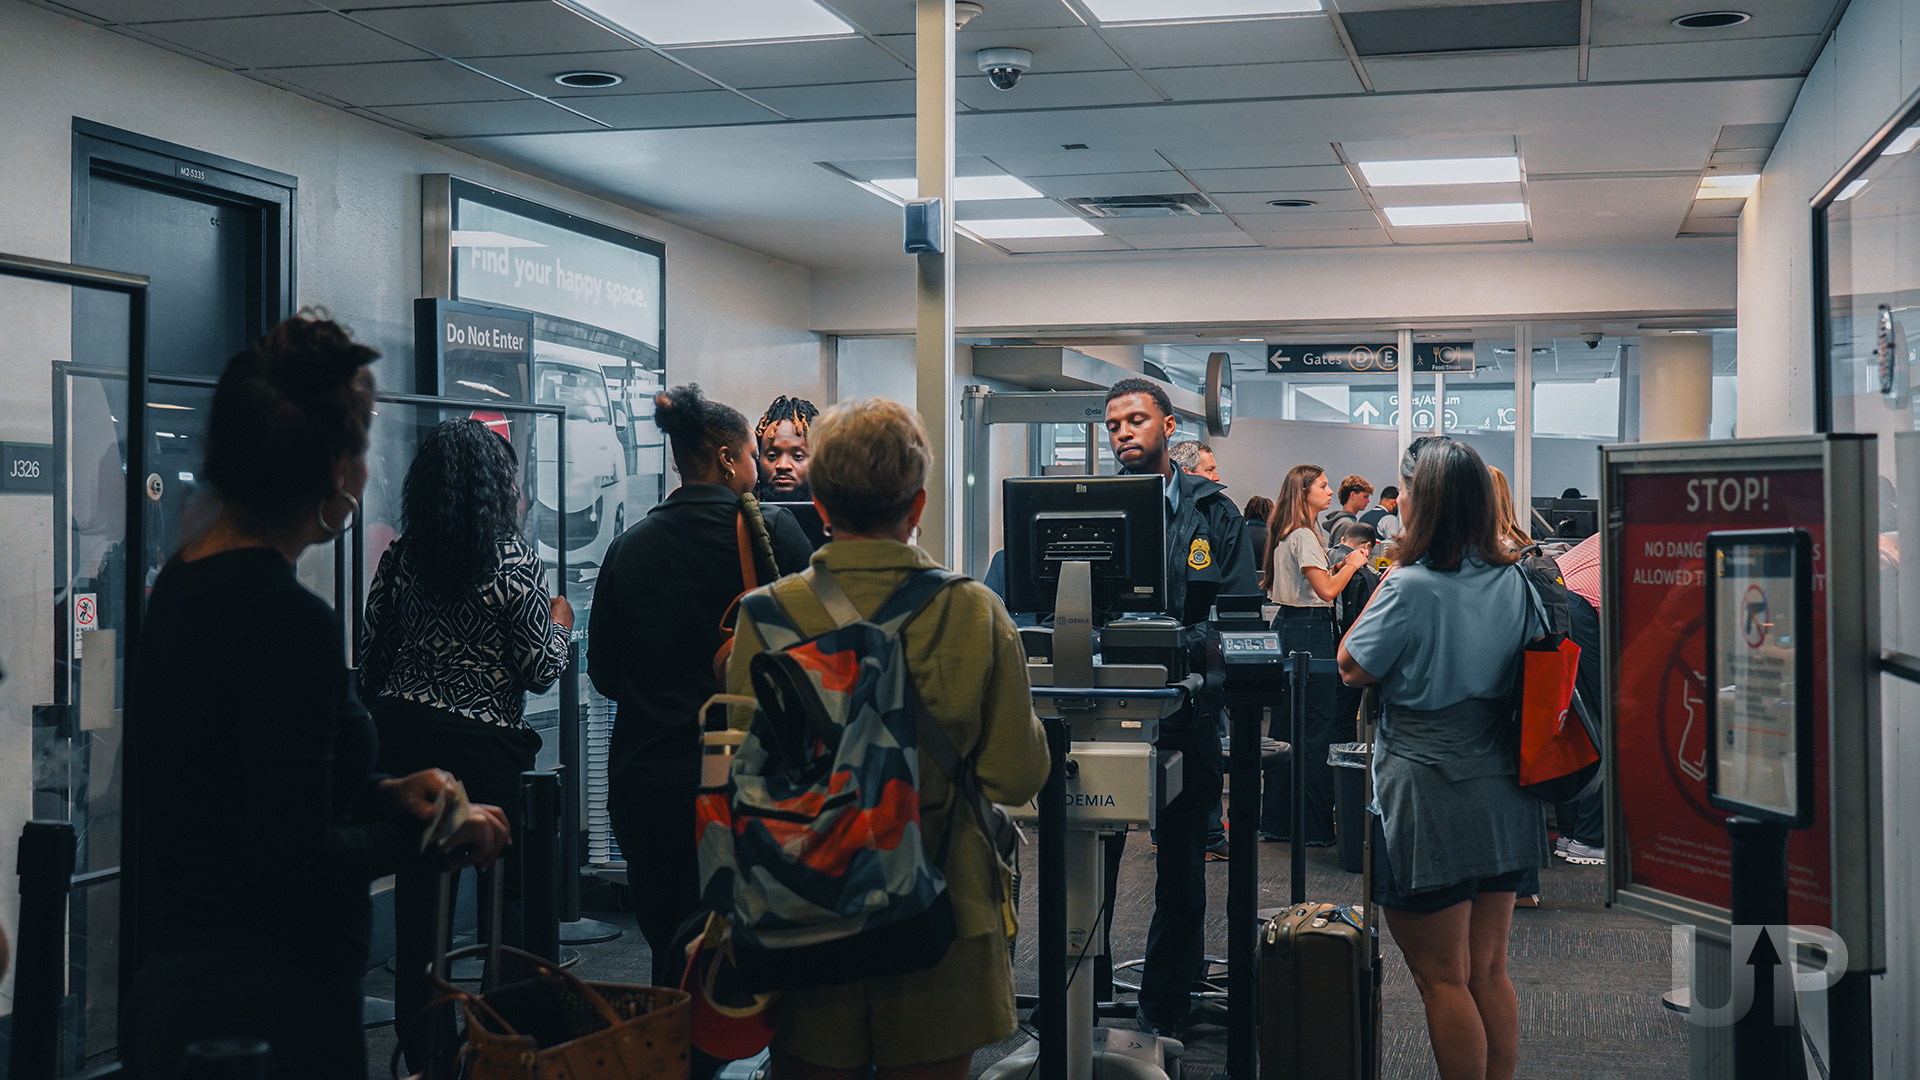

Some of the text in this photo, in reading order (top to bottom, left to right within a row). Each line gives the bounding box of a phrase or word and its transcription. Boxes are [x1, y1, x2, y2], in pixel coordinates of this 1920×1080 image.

[180, 166, 205, 180] M2-5335
[471, 247, 647, 310] Find your happy space.
[446, 322, 524, 350] Do Not Enter
[1303, 351, 1394, 365] Gates D E
[10, 459, 40, 478] J326
[1686, 476, 1769, 512] STOP!
[1644, 541, 1664, 557] NO
[1633, 568, 1692, 586] ALLOWED
[1066, 794, 1115, 807] DEMIA
